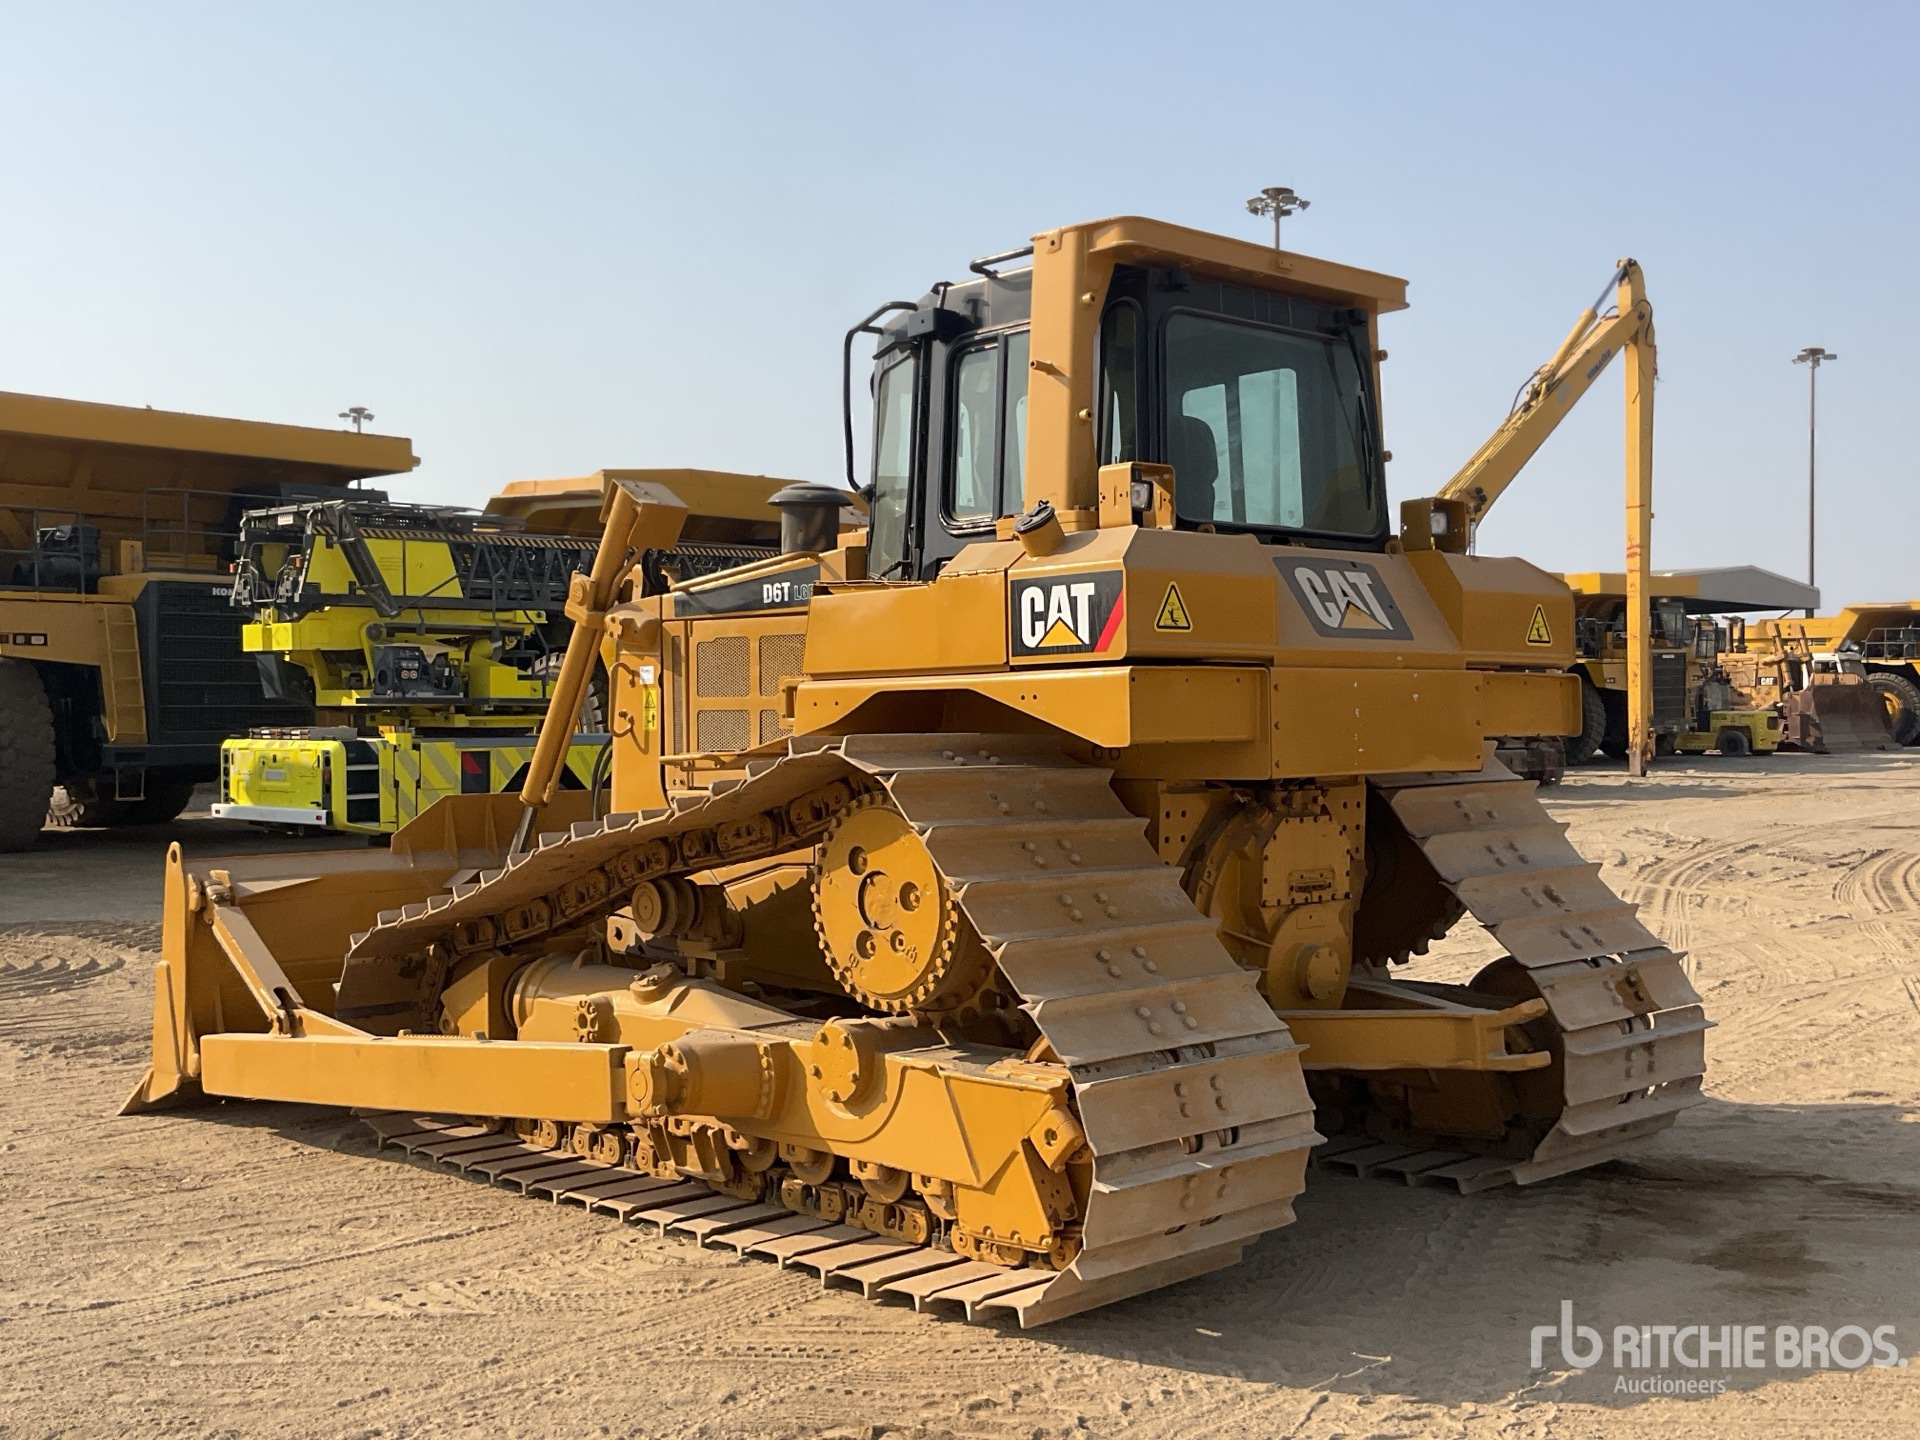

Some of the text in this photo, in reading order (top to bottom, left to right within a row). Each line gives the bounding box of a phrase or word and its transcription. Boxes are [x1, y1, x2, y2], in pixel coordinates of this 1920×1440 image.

[763, 582, 790, 603] D6T
[1296, 567, 1393, 630] CAT
[1020, 583, 1095, 649] CAT
[1760, 677, 1774, 686] CAT
